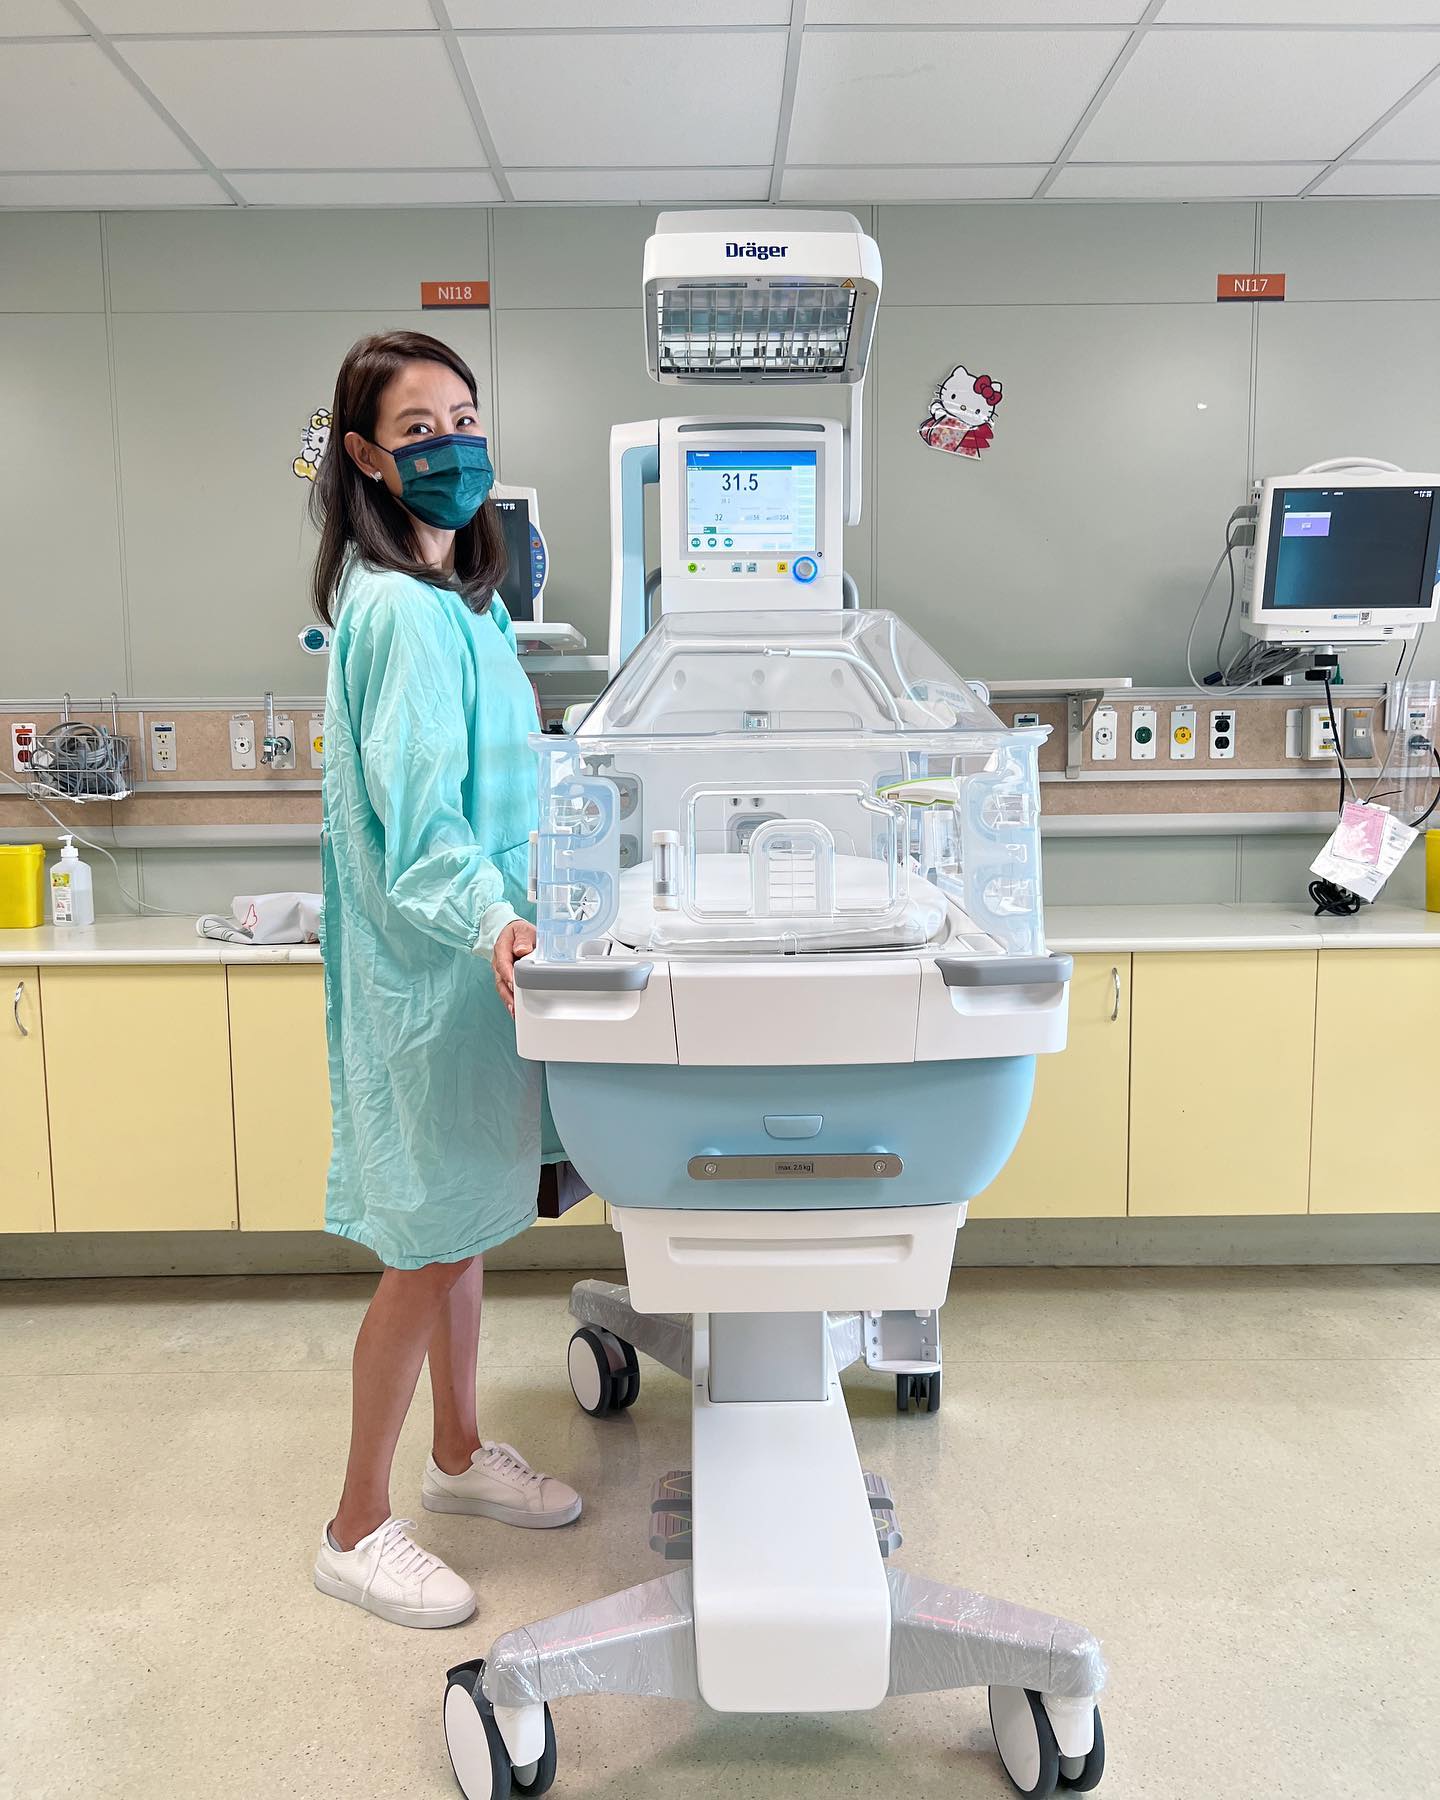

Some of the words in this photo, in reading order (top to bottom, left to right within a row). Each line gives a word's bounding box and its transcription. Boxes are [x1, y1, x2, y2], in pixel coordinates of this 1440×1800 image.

[725, 242, 788, 260] Dräger
[1234, 279, 1268, 292] NI17
[438, 286, 472, 300] NI18
[722, 473, 758, 491] 31.5
[803, 1164, 811, 1172] kg
